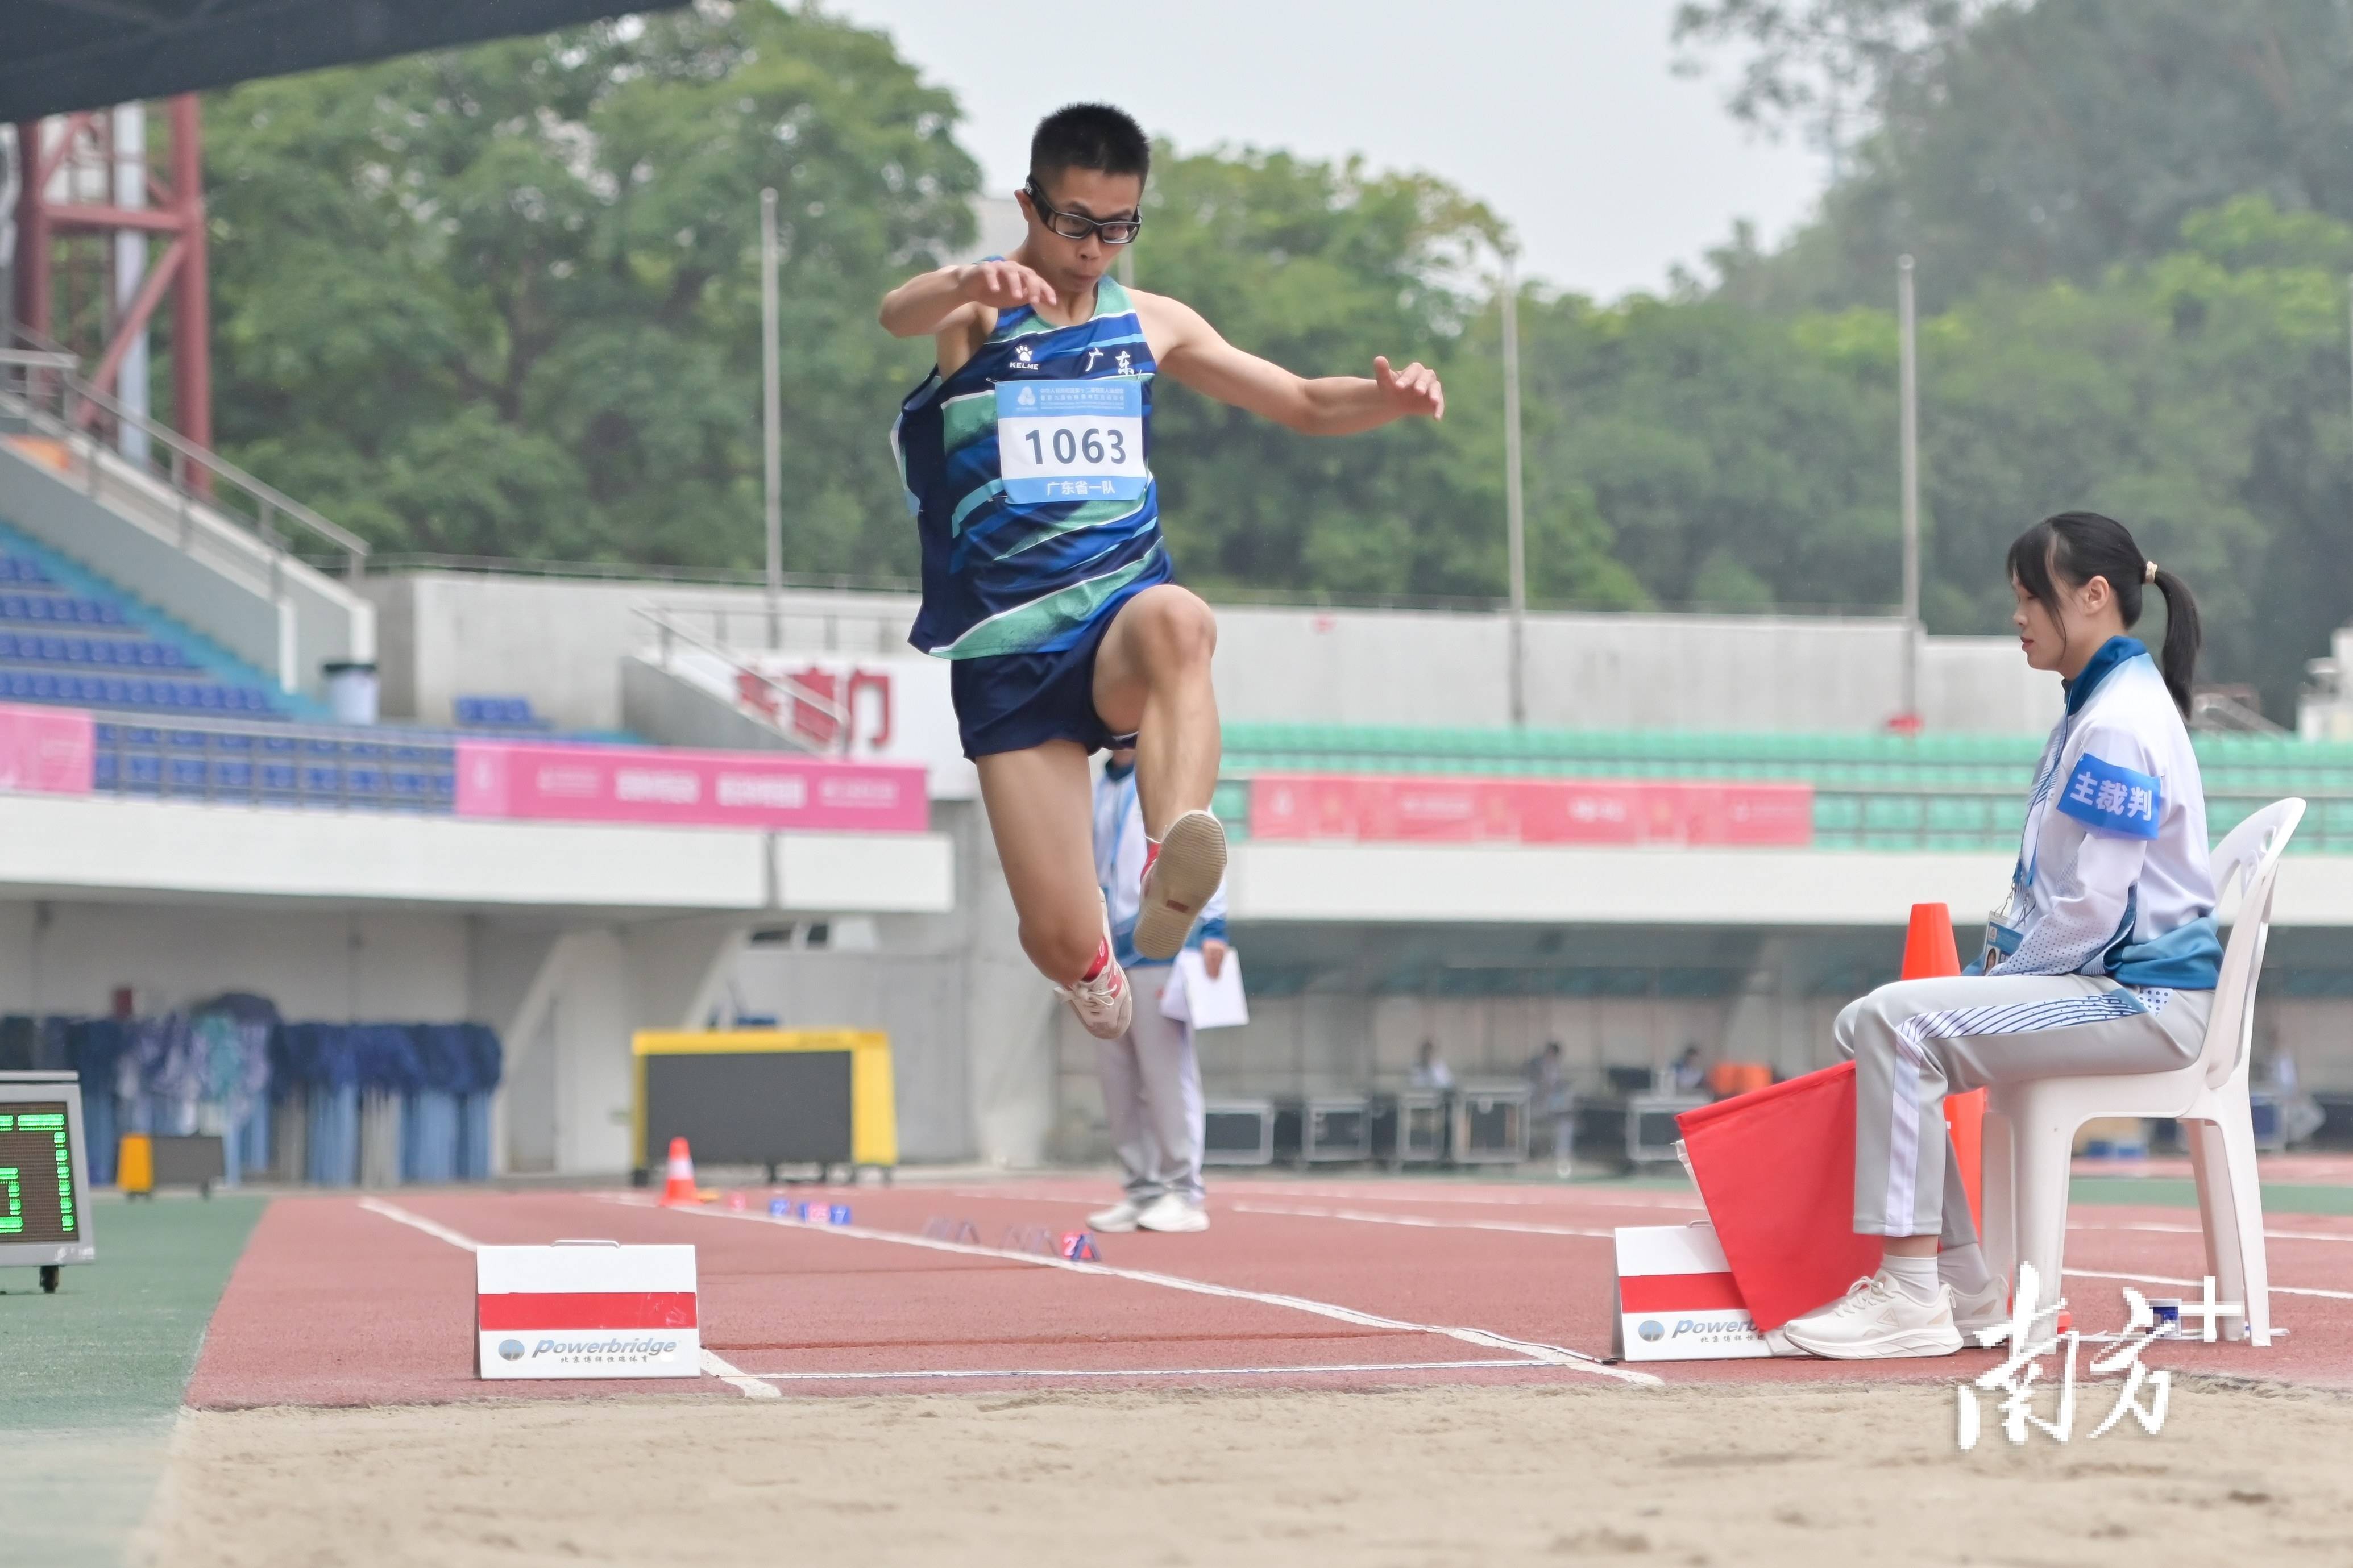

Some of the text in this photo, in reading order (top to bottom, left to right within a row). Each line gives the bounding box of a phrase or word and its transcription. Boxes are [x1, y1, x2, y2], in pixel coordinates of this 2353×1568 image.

[1010, 361, 1039, 370] KELME
[1085, 347, 1134, 375] 广东
[1025, 428, 1126, 465] 1063
[1047, 480, 1115, 496] 广东省一队
[2070, 771, 2152, 821] 主裁判
